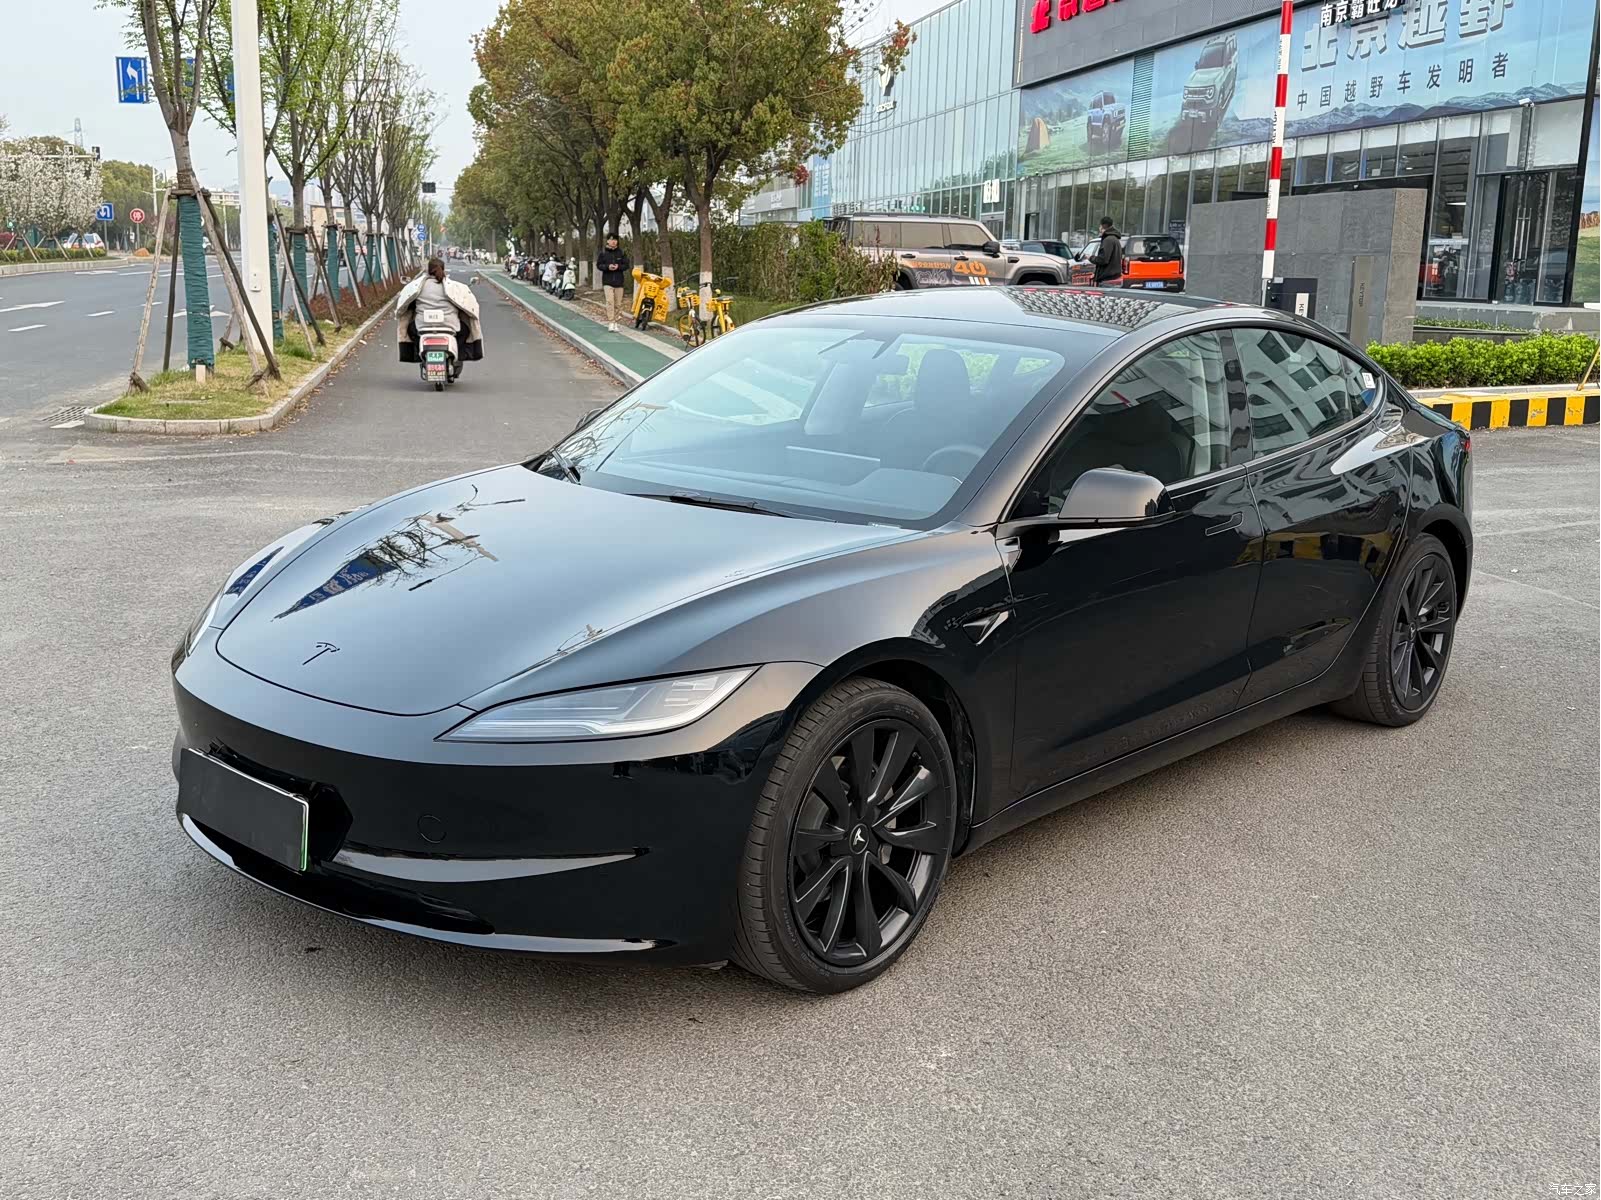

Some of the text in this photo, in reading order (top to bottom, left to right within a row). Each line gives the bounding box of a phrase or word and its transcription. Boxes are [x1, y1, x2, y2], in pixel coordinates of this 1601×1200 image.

[1297, 52, 1509, 112] 中国越野车发明者
